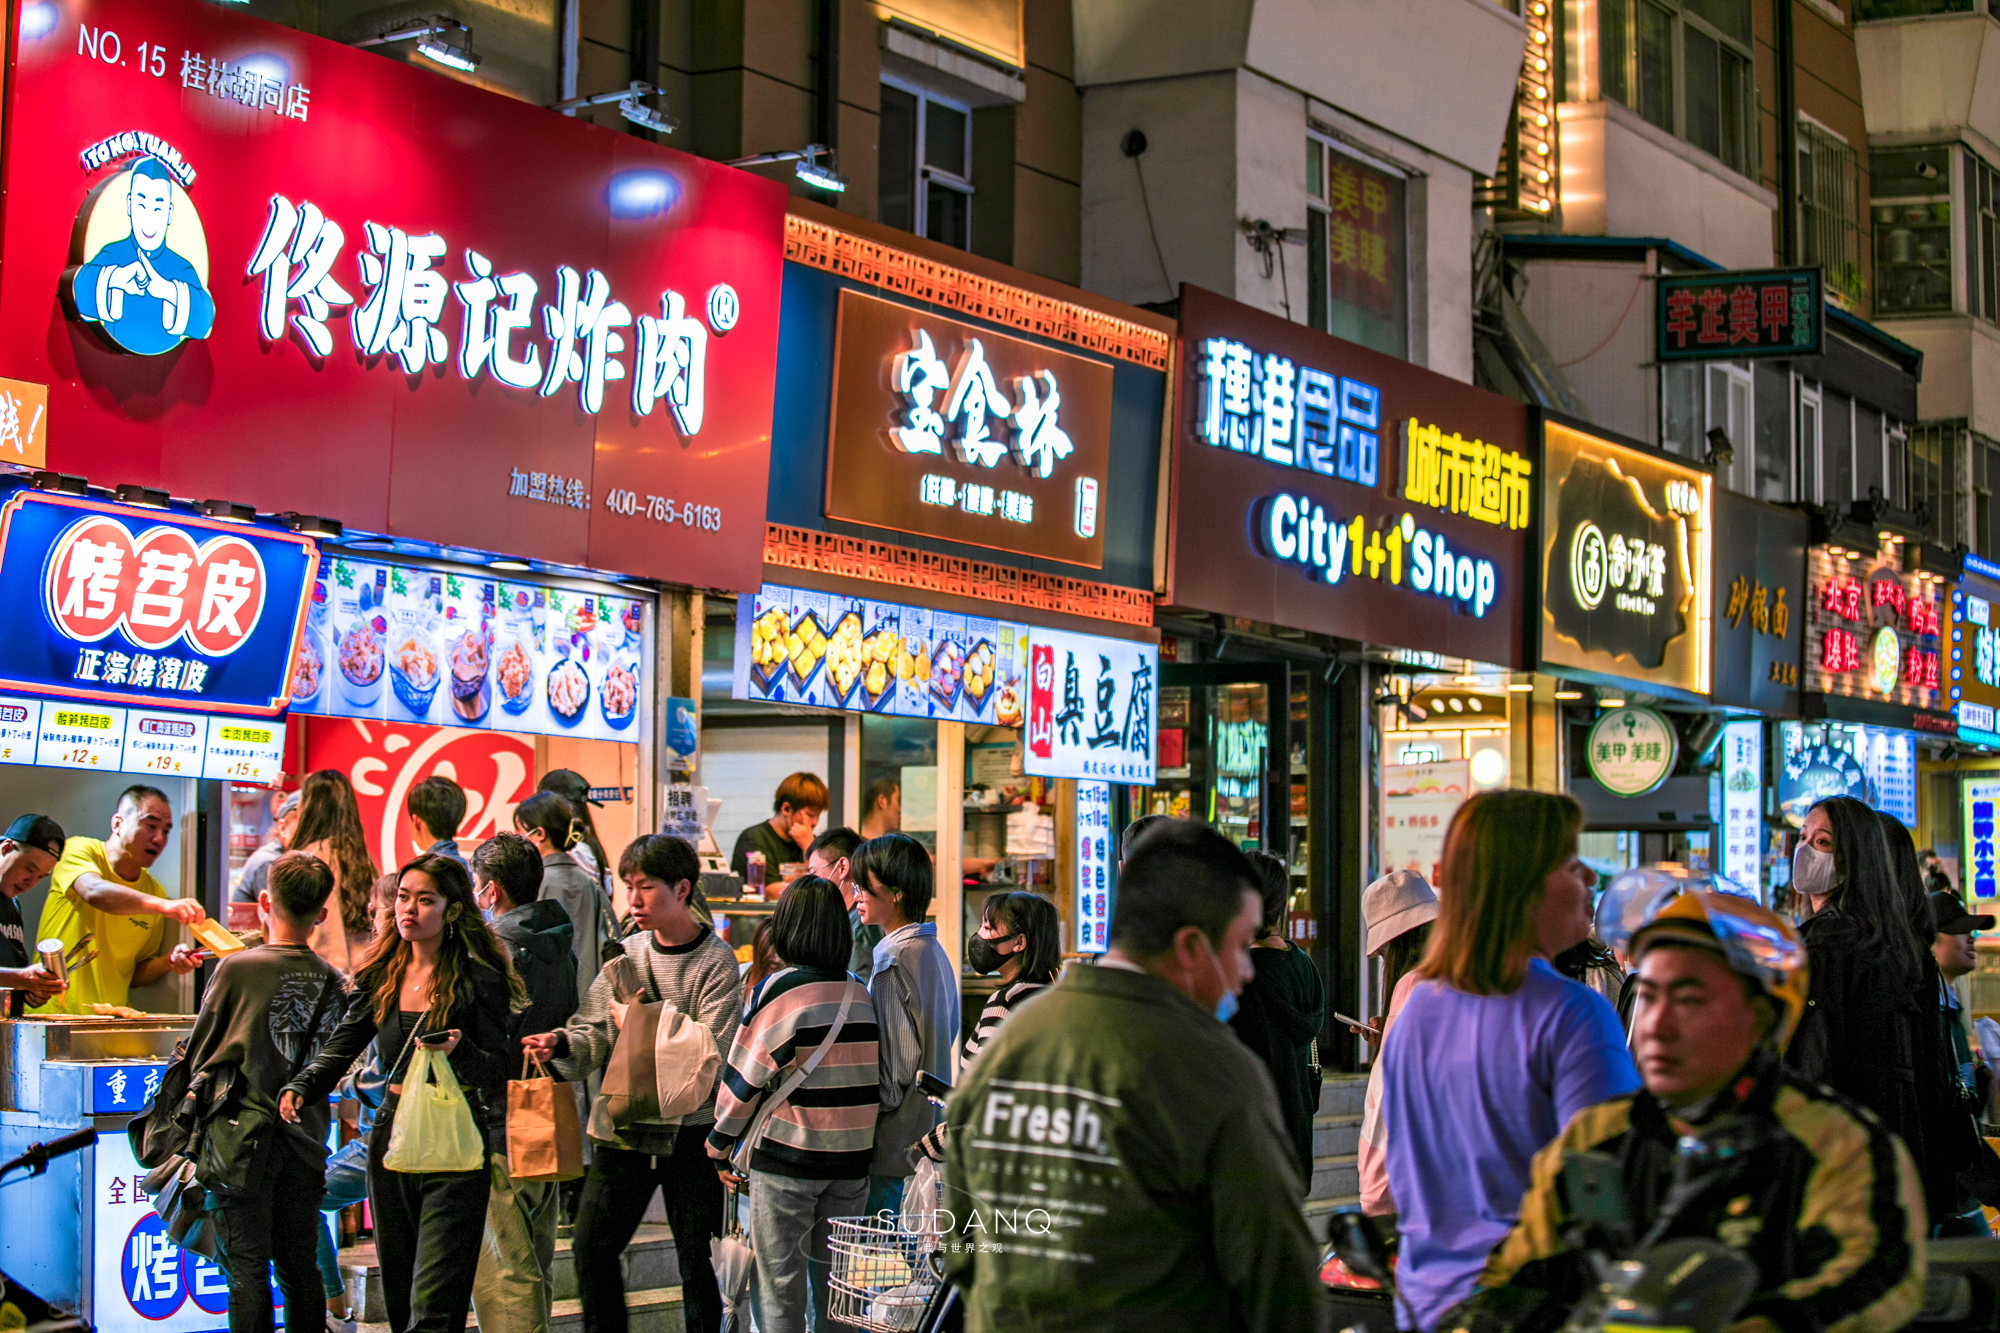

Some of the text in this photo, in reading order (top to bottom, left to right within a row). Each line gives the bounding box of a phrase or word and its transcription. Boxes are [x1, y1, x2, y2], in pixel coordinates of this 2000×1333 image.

[78, 23, 310, 122] NO. 15 桂林胡同店
[247, 194, 708, 436] 佟源记炸肉
[1667, 286, 1788, 347] 芊芷美甲
[1205, 337, 1380, 487] 穗港食品
[606, 488, 721, 531] 400-765-6163
[1405, 417, 1531, 530] 城市超市
[61, 539, 256, 637] 烤苕皮
[1825, 577, 1862, 621] 北京
[1032, 658, 1053, 746] 白山
[1907, 646, 1939, 689] 粉丝
[1596, 743, 1627, 763] 美甲
[667, 790, 692, 808] 招聘
